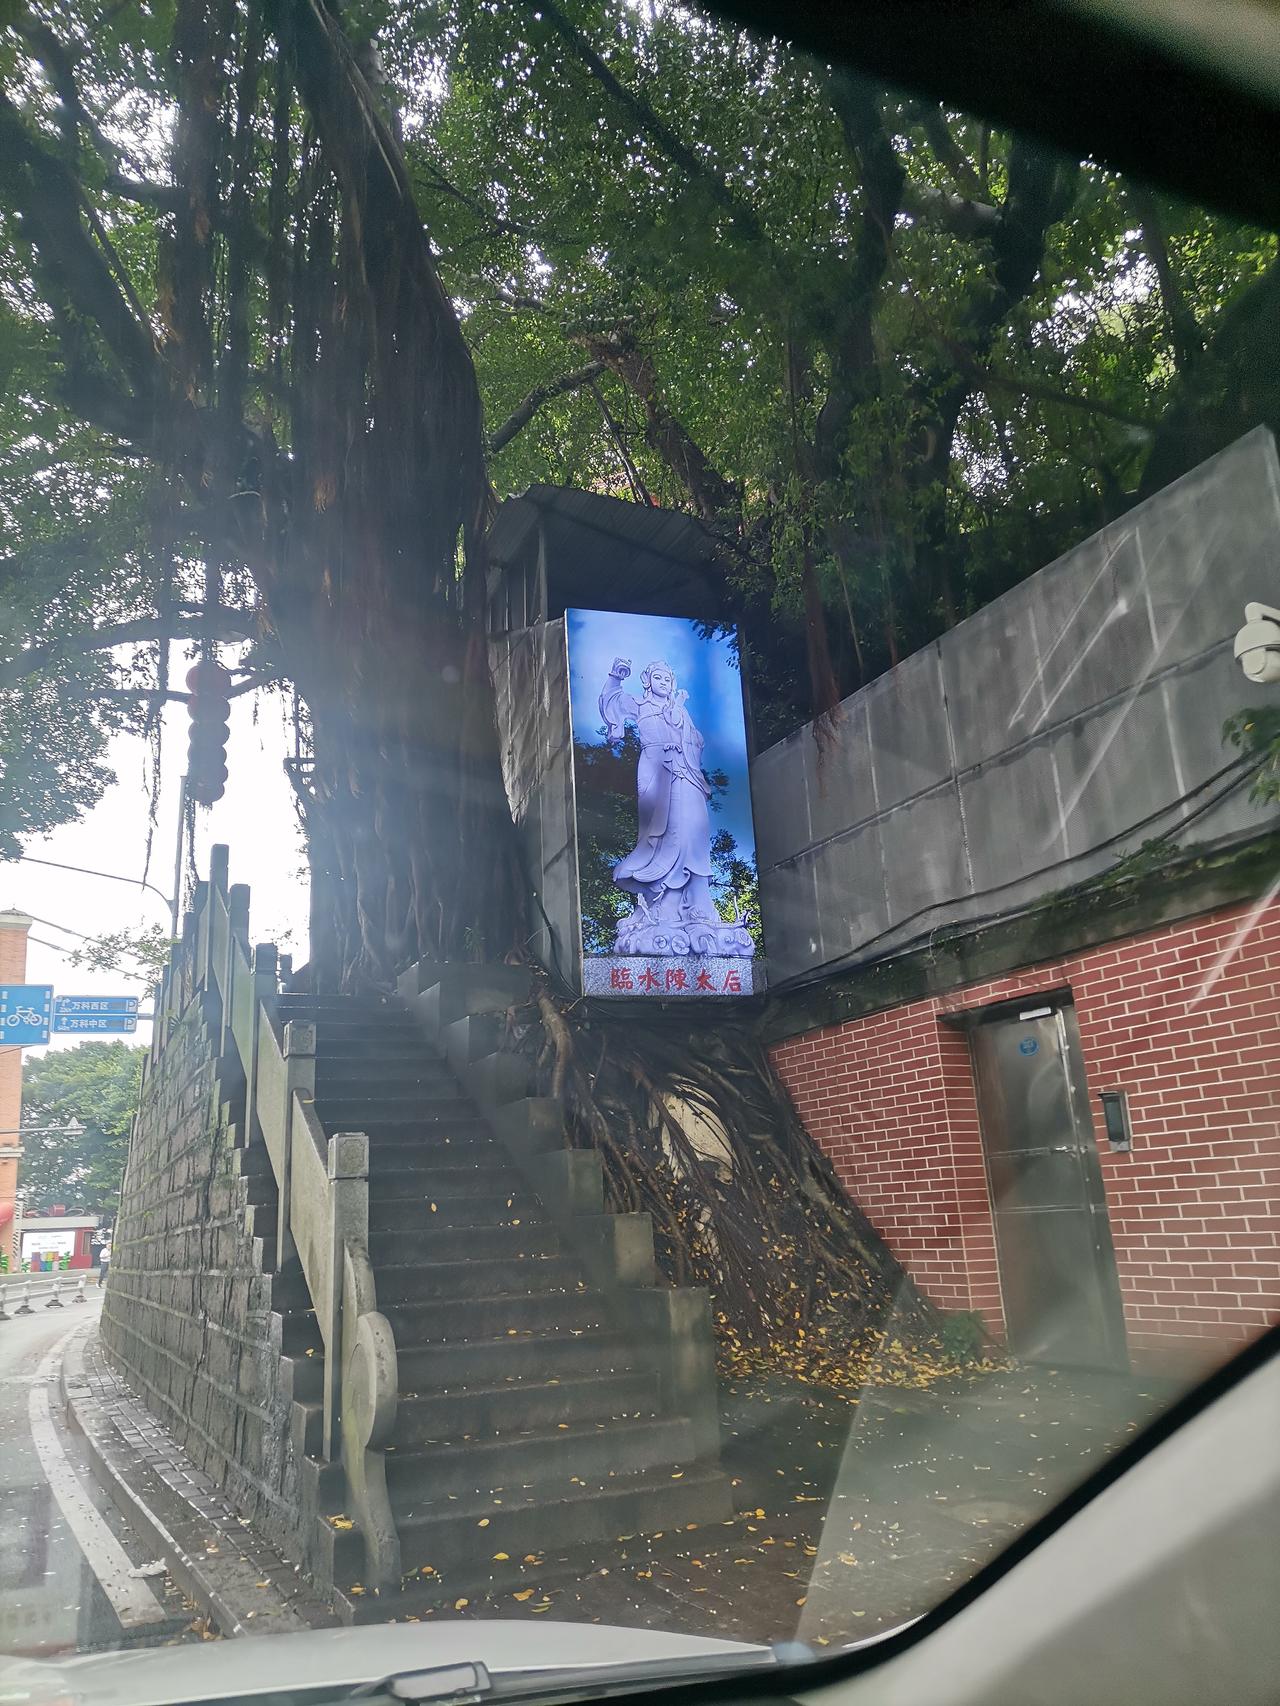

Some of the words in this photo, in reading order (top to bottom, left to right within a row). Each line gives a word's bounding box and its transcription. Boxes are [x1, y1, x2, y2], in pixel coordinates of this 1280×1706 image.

[610, 967, 742, 992] 臨水陳太后
[72, 1001, 108, 1010] 万科西区
[70, 1019, 107, 1028] 万科中区
